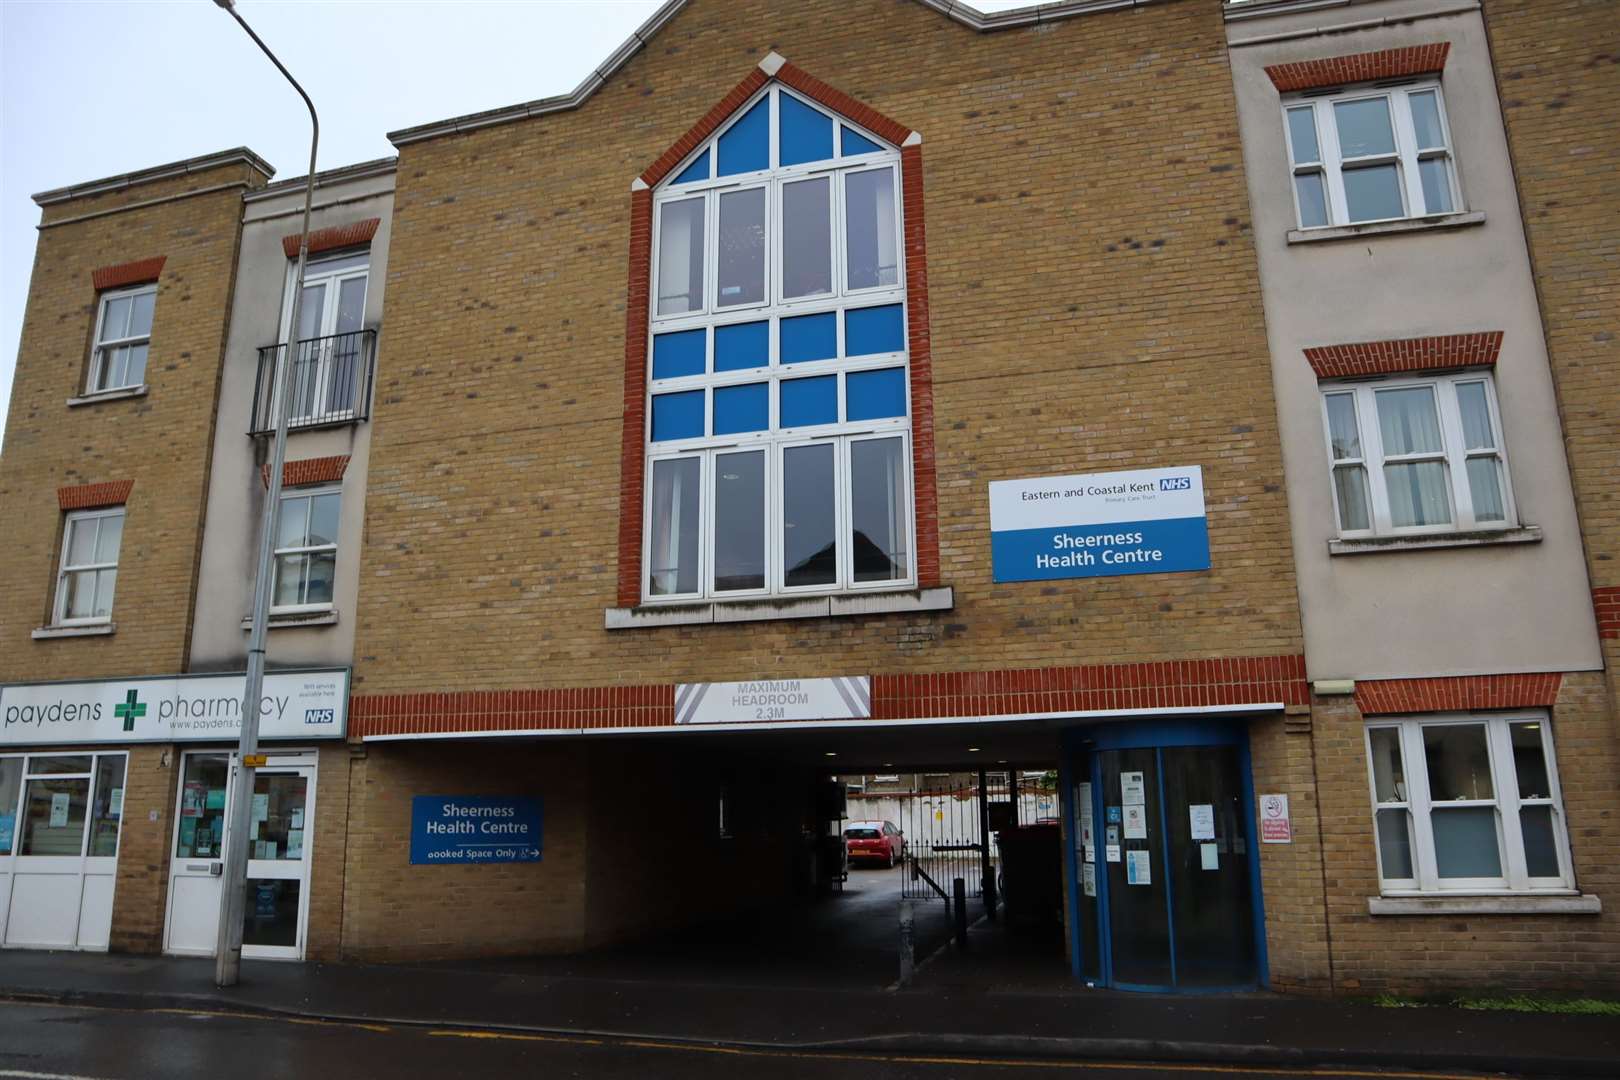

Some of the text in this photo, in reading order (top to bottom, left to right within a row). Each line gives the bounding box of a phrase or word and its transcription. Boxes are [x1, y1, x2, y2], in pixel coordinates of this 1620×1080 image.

[1022, 478, 1190, 501] Eastern and Coastal Kent NHS
[1053, 532, 1143, 550] Sheerness
[1036, 548, 1163, 569] Health Centre
[737, 680, 801, 694] MAXIMUM
[732, 693, 809, 707] HEADROOM
[5, 700, 102, 728] paydens
[305, 710, 333, 723] NHS
[756, 706, 785, 719] 2.3M
[169, 719, 242, 729] www.paydens.c
[443, 803, 515, 817] Sheerness
[427, 820, 528, 834] Health Centre
[466, 849, 492, 859] Space
[496, 847, 516, 858] Only
